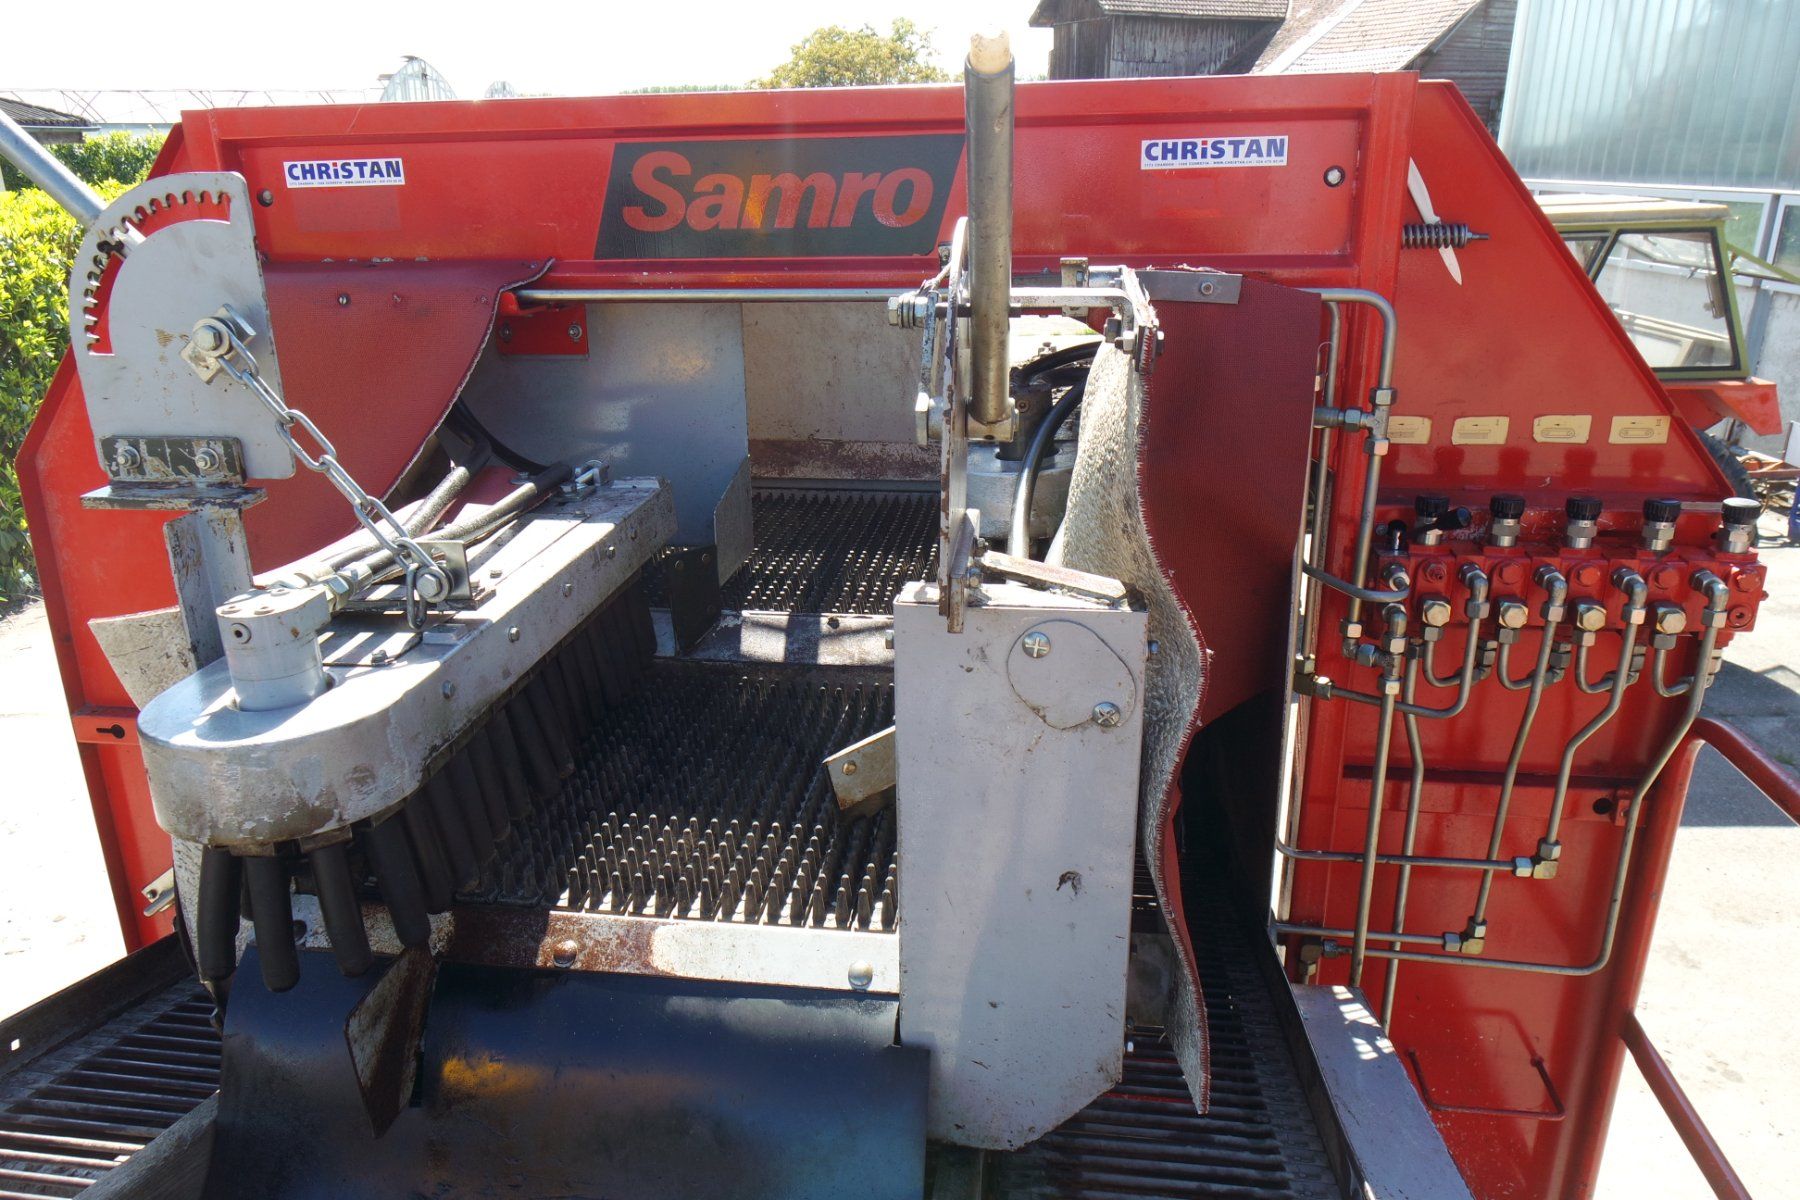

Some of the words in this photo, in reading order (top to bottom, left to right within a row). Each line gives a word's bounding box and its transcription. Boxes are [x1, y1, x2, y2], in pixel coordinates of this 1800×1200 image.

[1144, 138, 1286, 161] CHRiSTAN
[287, 160, 402, 181] CHRiSTAN
[621, 150, 935, 232] Samro
